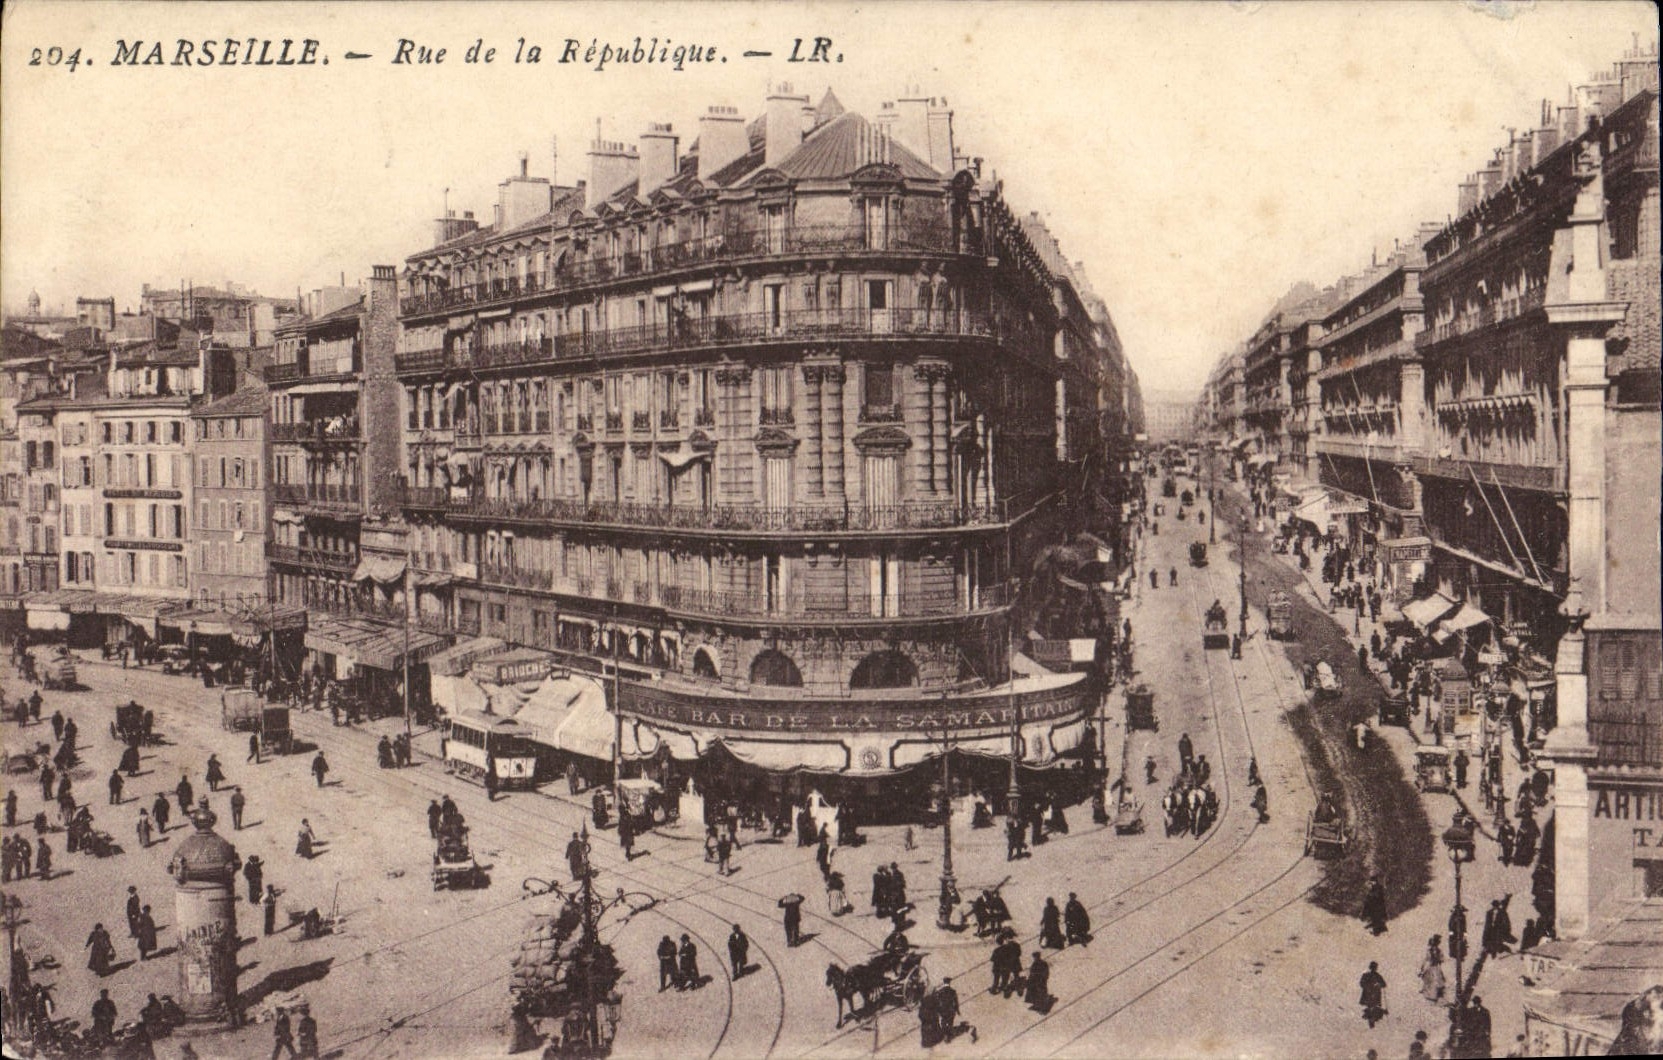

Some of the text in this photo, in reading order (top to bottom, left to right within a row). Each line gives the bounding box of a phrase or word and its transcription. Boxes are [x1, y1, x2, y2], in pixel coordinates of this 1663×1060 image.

[691, 709, 747, 727] BAR
[765, 714, 808, 729] DE
[831, 716, 877, 729] LA
